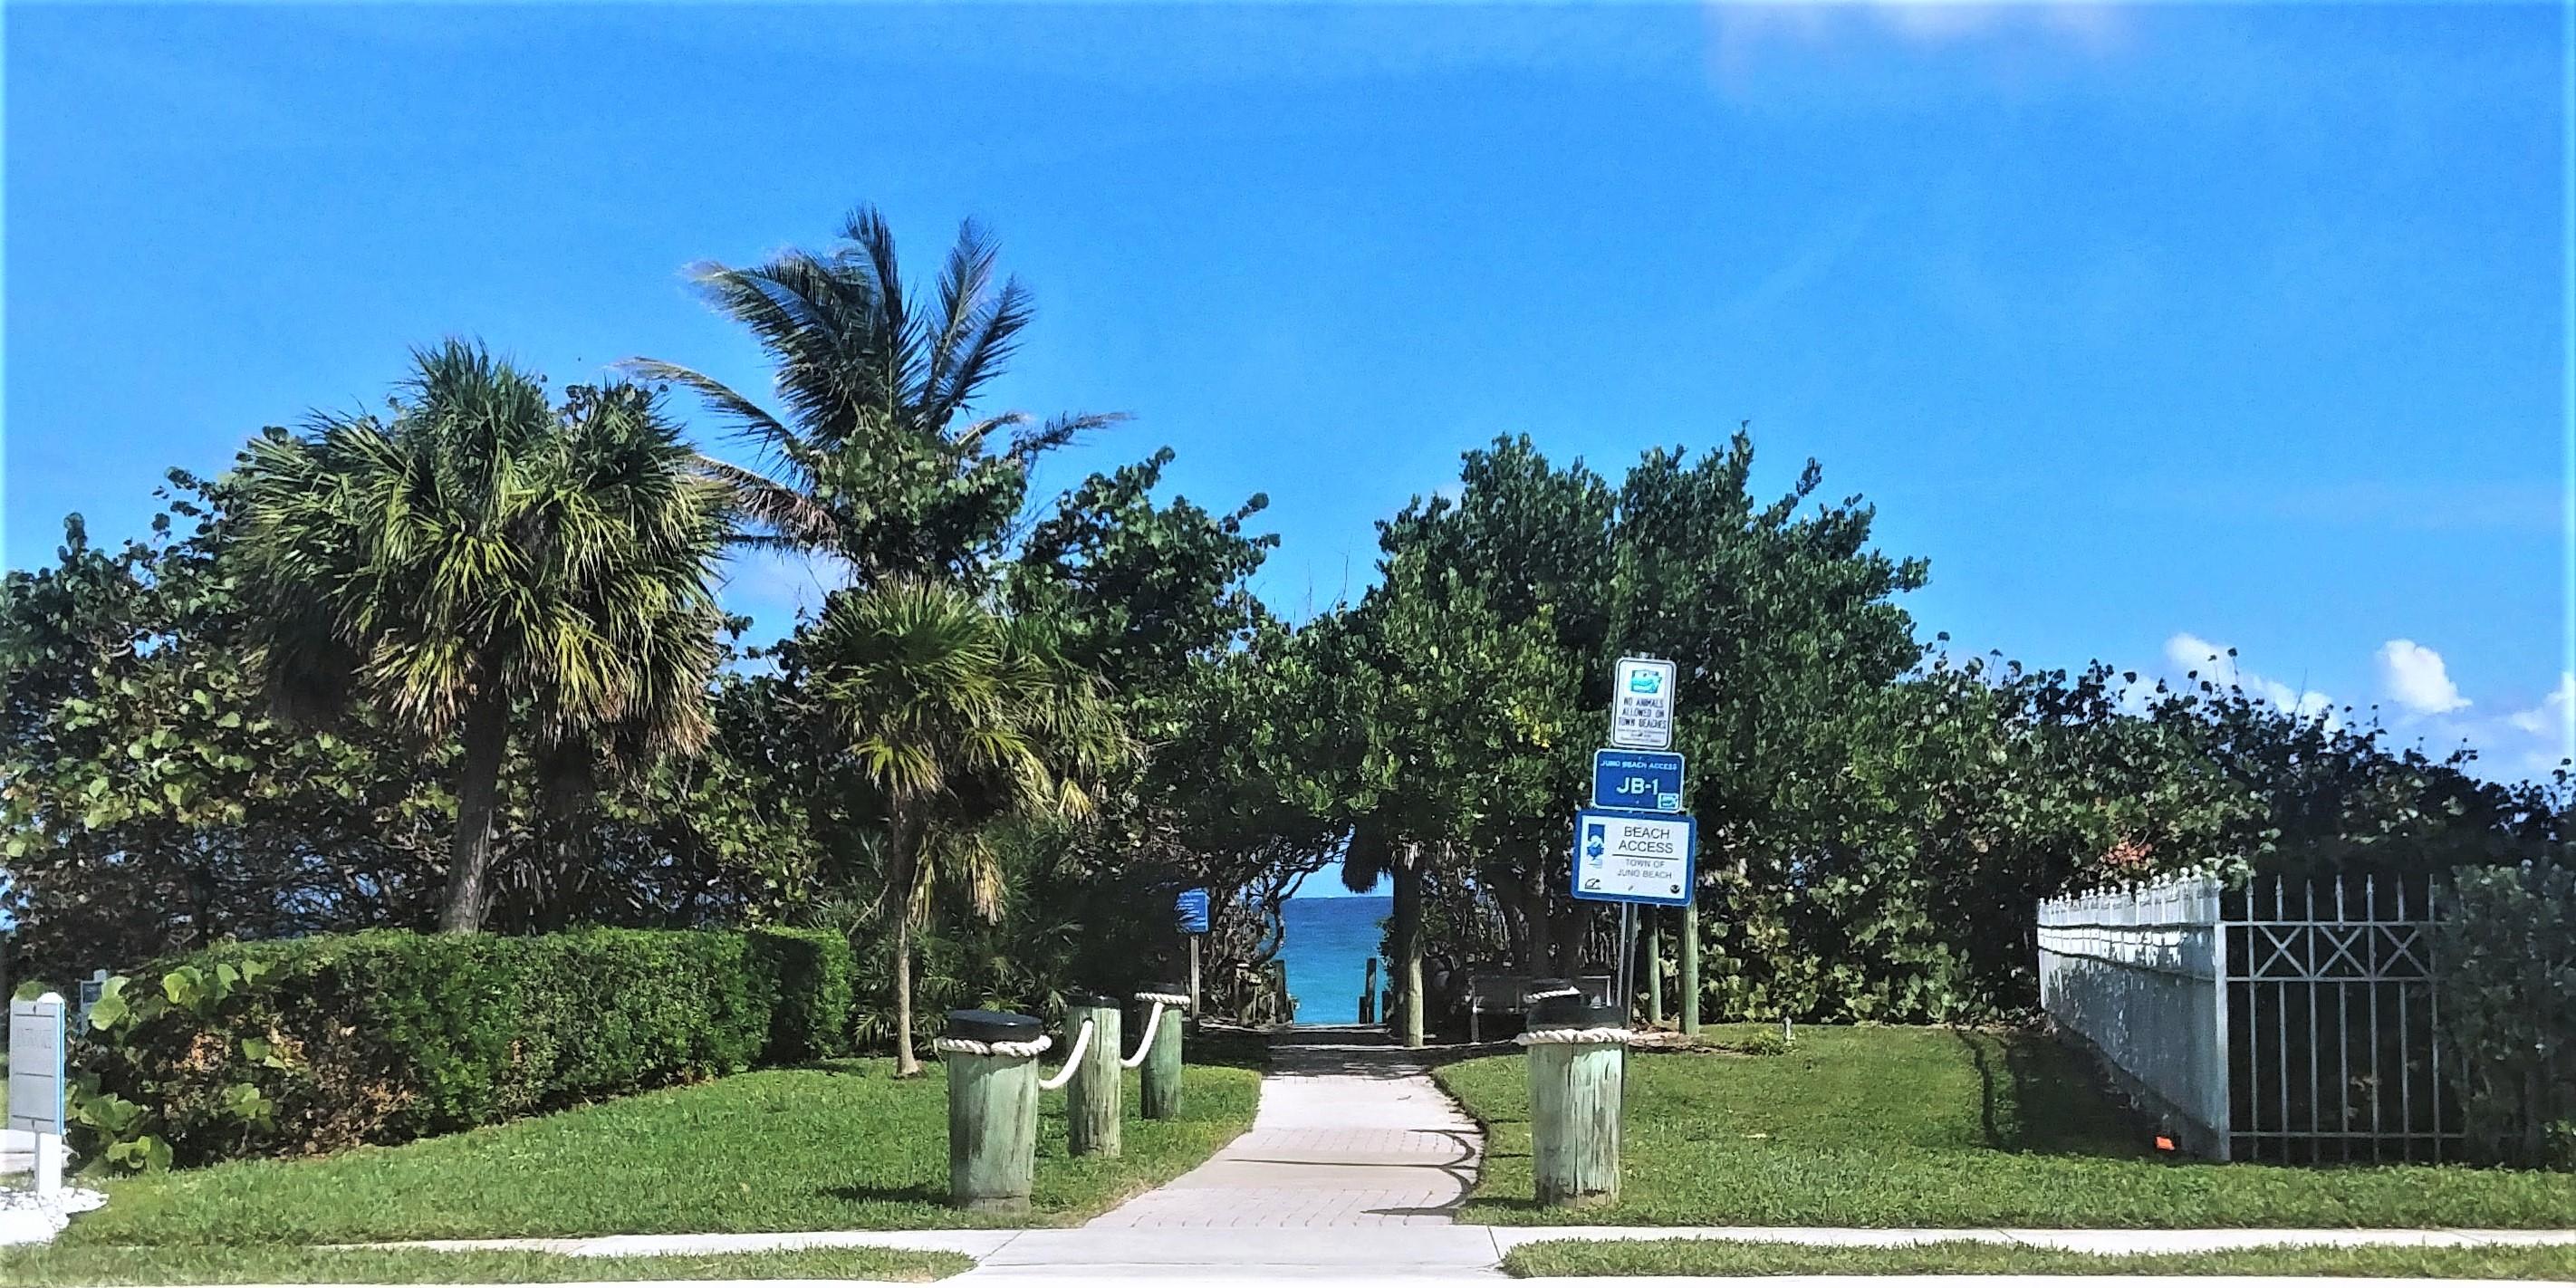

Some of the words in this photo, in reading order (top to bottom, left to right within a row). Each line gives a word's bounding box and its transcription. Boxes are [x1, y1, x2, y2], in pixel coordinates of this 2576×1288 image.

[1624, 697, 1633, 706] NO
[1637, 698, 1664, 708] ANIMALS
[1622, 707, 1652, 717] ALLOWED
[1655, 709, 1665, 718] ON
[1619, 717, 1636, 726] TOWN
[1639, 718, 1668, 729] BEACHES
[1622, 761, 1648, 769] BEACH
[1648, 763, 1677, 771] ACCESS
[1616, 776, 1658, 795] JB-1
[1624, 826, 1670, 839] BEACH
[1619, 840, 1674, 854] ACCESS
[1626, 859, 1650, 868] TOWN
[1653, 860, 1666, 869] OF
[1618, 869, 1640, 878] JUNO
[1642, 870, 1672, 879] BEACH
